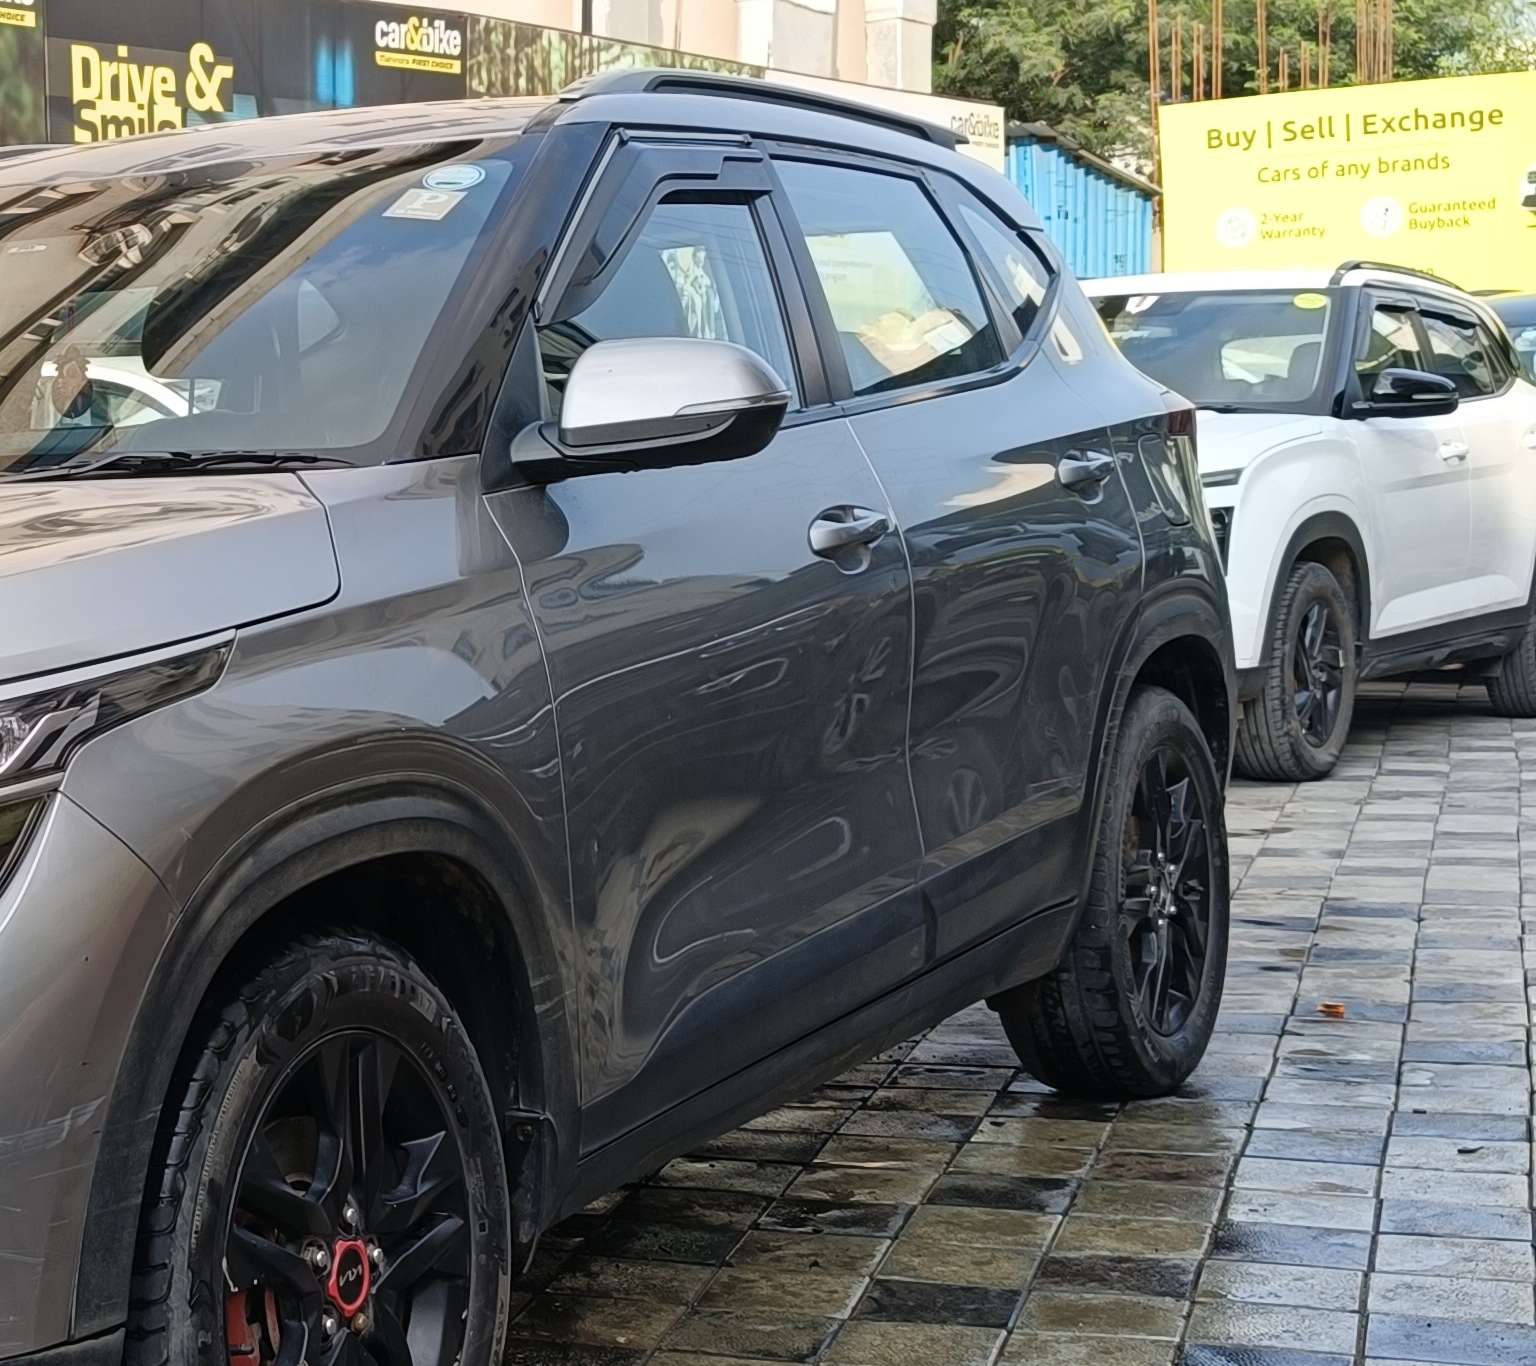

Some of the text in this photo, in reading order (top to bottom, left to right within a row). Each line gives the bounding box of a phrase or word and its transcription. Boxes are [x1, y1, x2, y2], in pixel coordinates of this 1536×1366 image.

[375, 16, 462, 56] car&bike
[71, 42, 234, 112] Drive &
[73, 98, 178, 142] Smil
[1207, 128, 1257, 151] Buy
[1283, 115, 1335, 142] Sell
[1362, 108, 1504, 136] Exchange
[1258, 152, 1451, 183] Cars of any brands
[1409, 197, 1496, 214] Guaranteed
[1260, 226, 1325, 240] Warranty
[1409, 215, 1470, 232] Buyback
